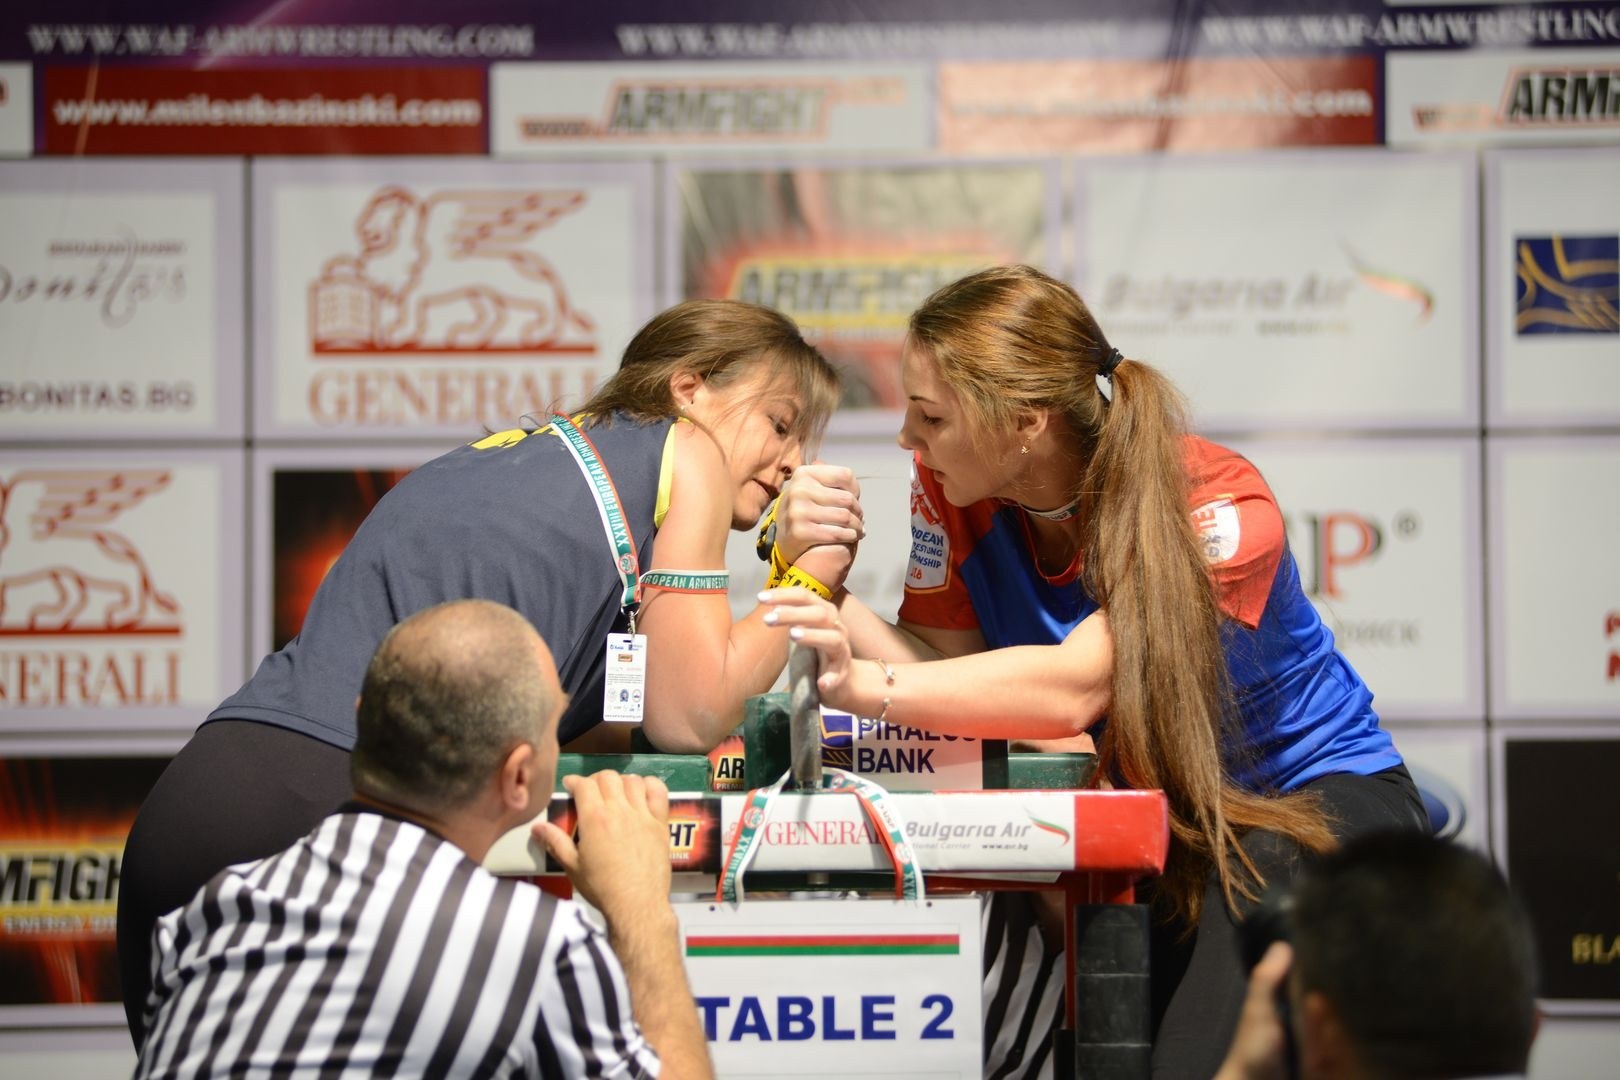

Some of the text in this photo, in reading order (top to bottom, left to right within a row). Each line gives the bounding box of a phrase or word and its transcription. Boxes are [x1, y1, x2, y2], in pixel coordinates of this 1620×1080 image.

[858, 748, 935, 773] BANK
[906, 821, 997, 841] Bulgaria
[1000, 821, 1031, 837] Air
[694, 994, 954, 1041] TABLE 2
